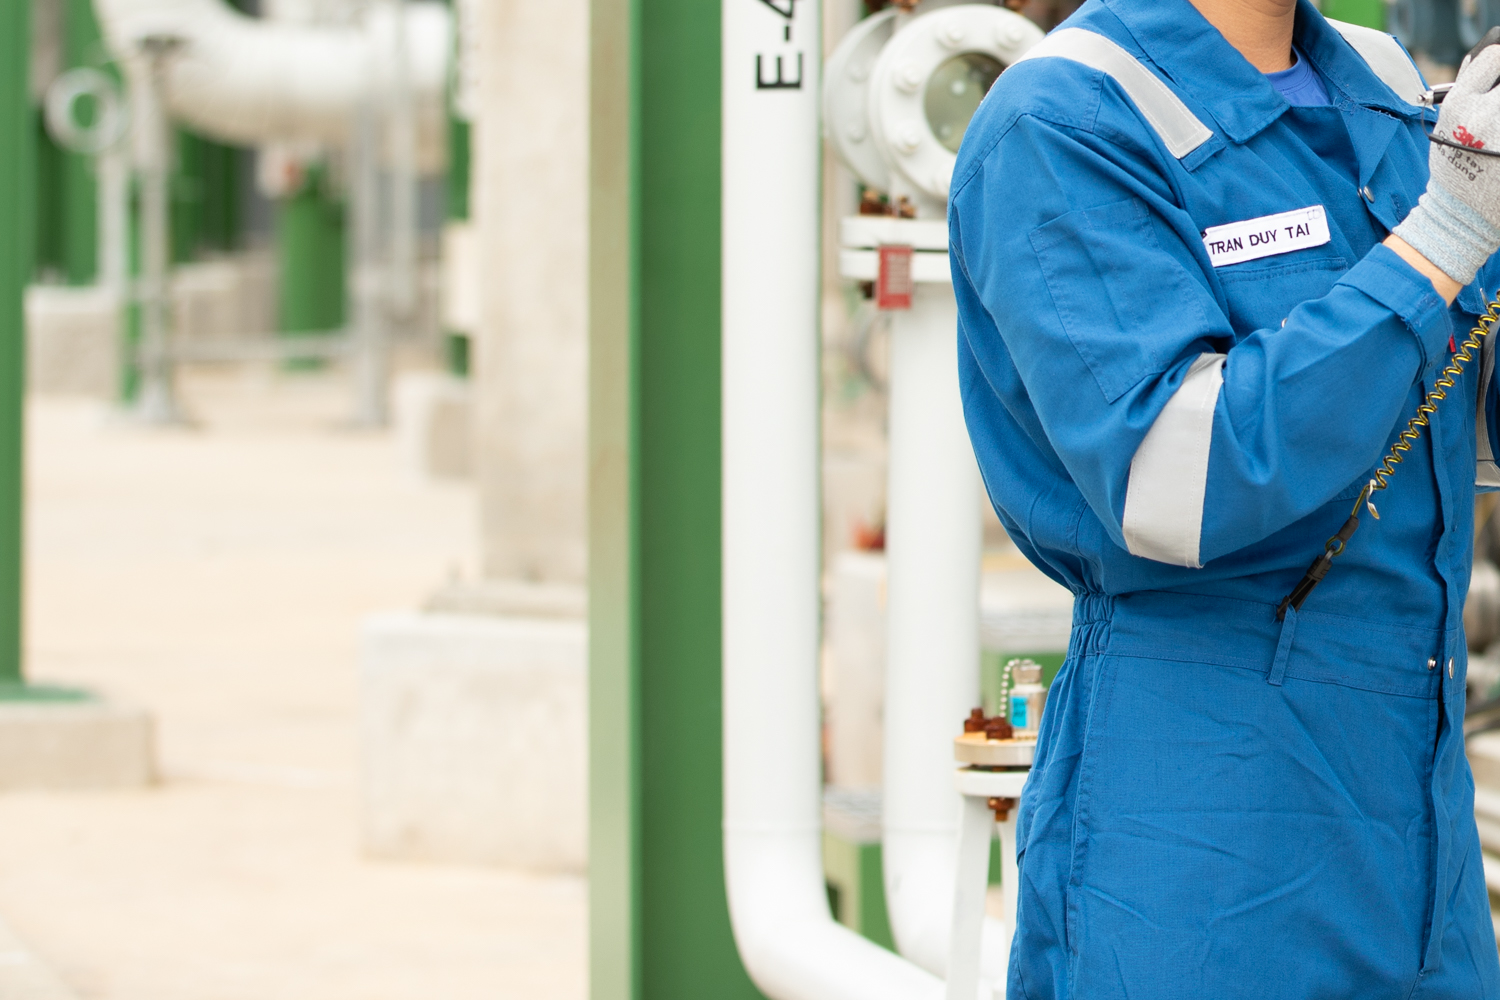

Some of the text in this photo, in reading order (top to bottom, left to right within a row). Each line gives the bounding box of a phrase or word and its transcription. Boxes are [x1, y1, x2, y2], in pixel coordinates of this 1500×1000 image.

[1452, 125, 1485, 150] 3M
[1466, 156, 1485, 173] tay
[1209, 222, 1311, 255] TRAN DUY TAI
